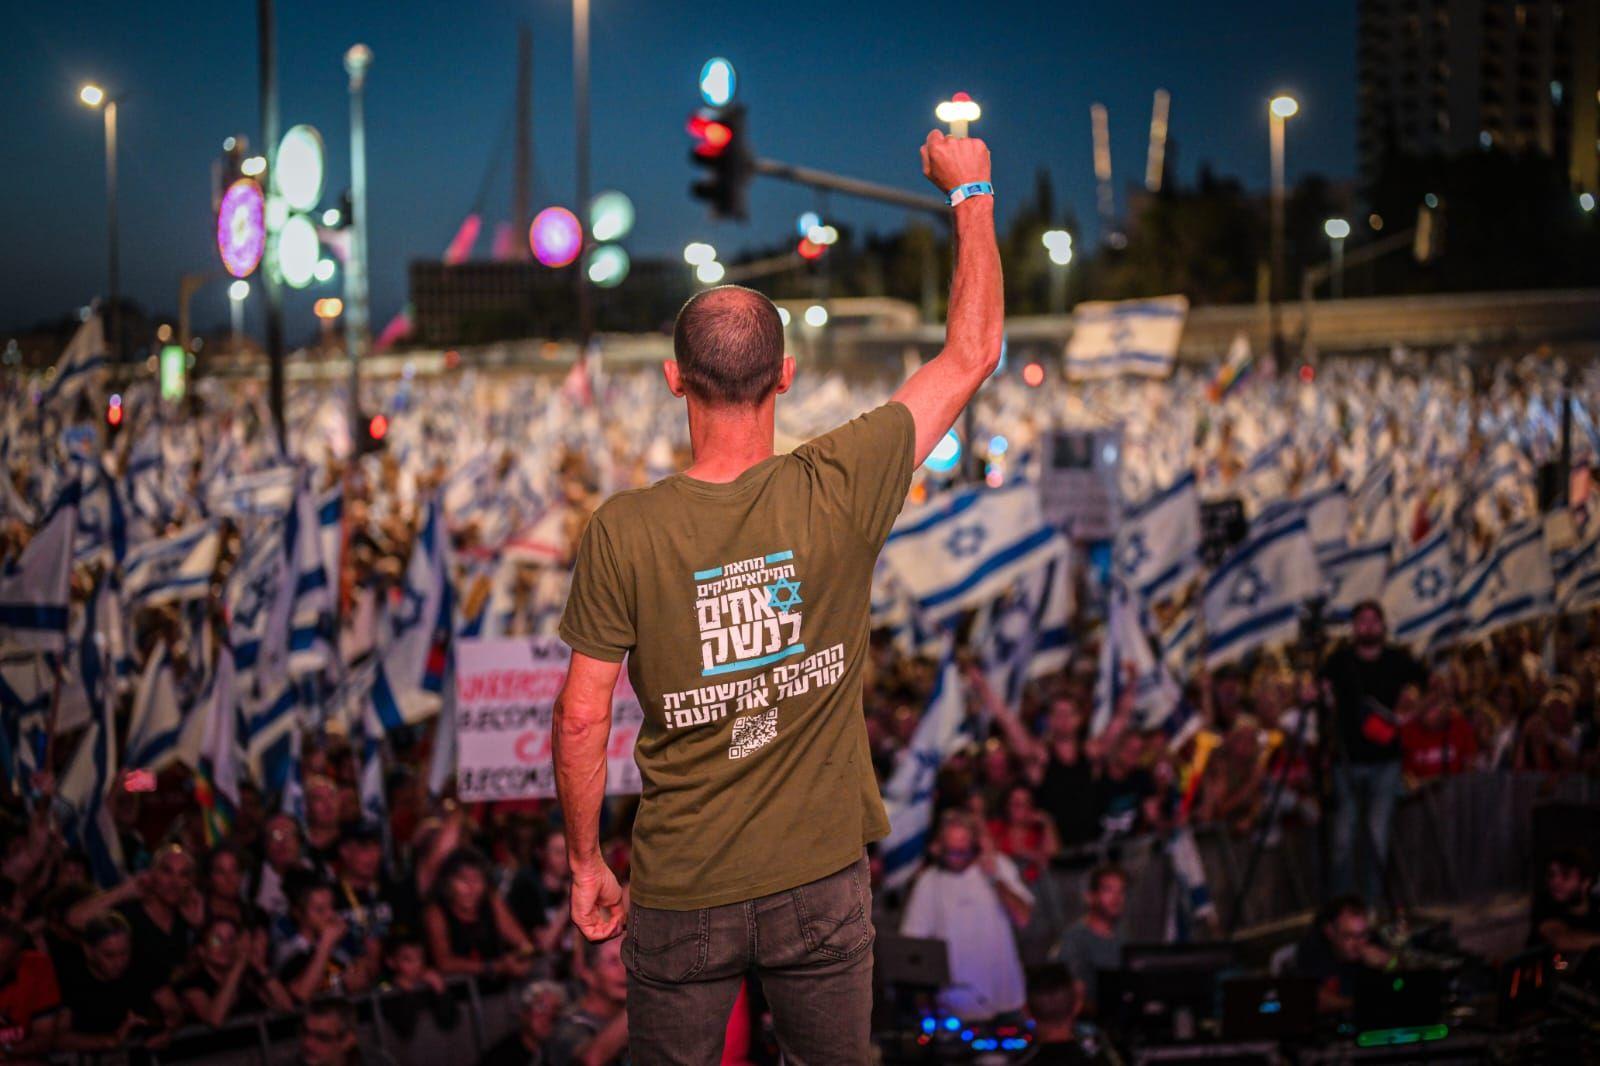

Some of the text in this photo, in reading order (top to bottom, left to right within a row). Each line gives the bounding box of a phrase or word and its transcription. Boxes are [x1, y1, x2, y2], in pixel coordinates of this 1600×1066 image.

[697, 564, 796, 597] המילואימניקים
[723, 556, 765, 577] מחאת
[696, 586, 777, 631] אחים
[700, 610, 803, 670] לנשק
[663, 643, 844, 710] ההפיכה המשטרית
[777, 661, 845, 701] קורעת
[665, 702, 727, 729] העם!
[736, 688, 769, 712] את
